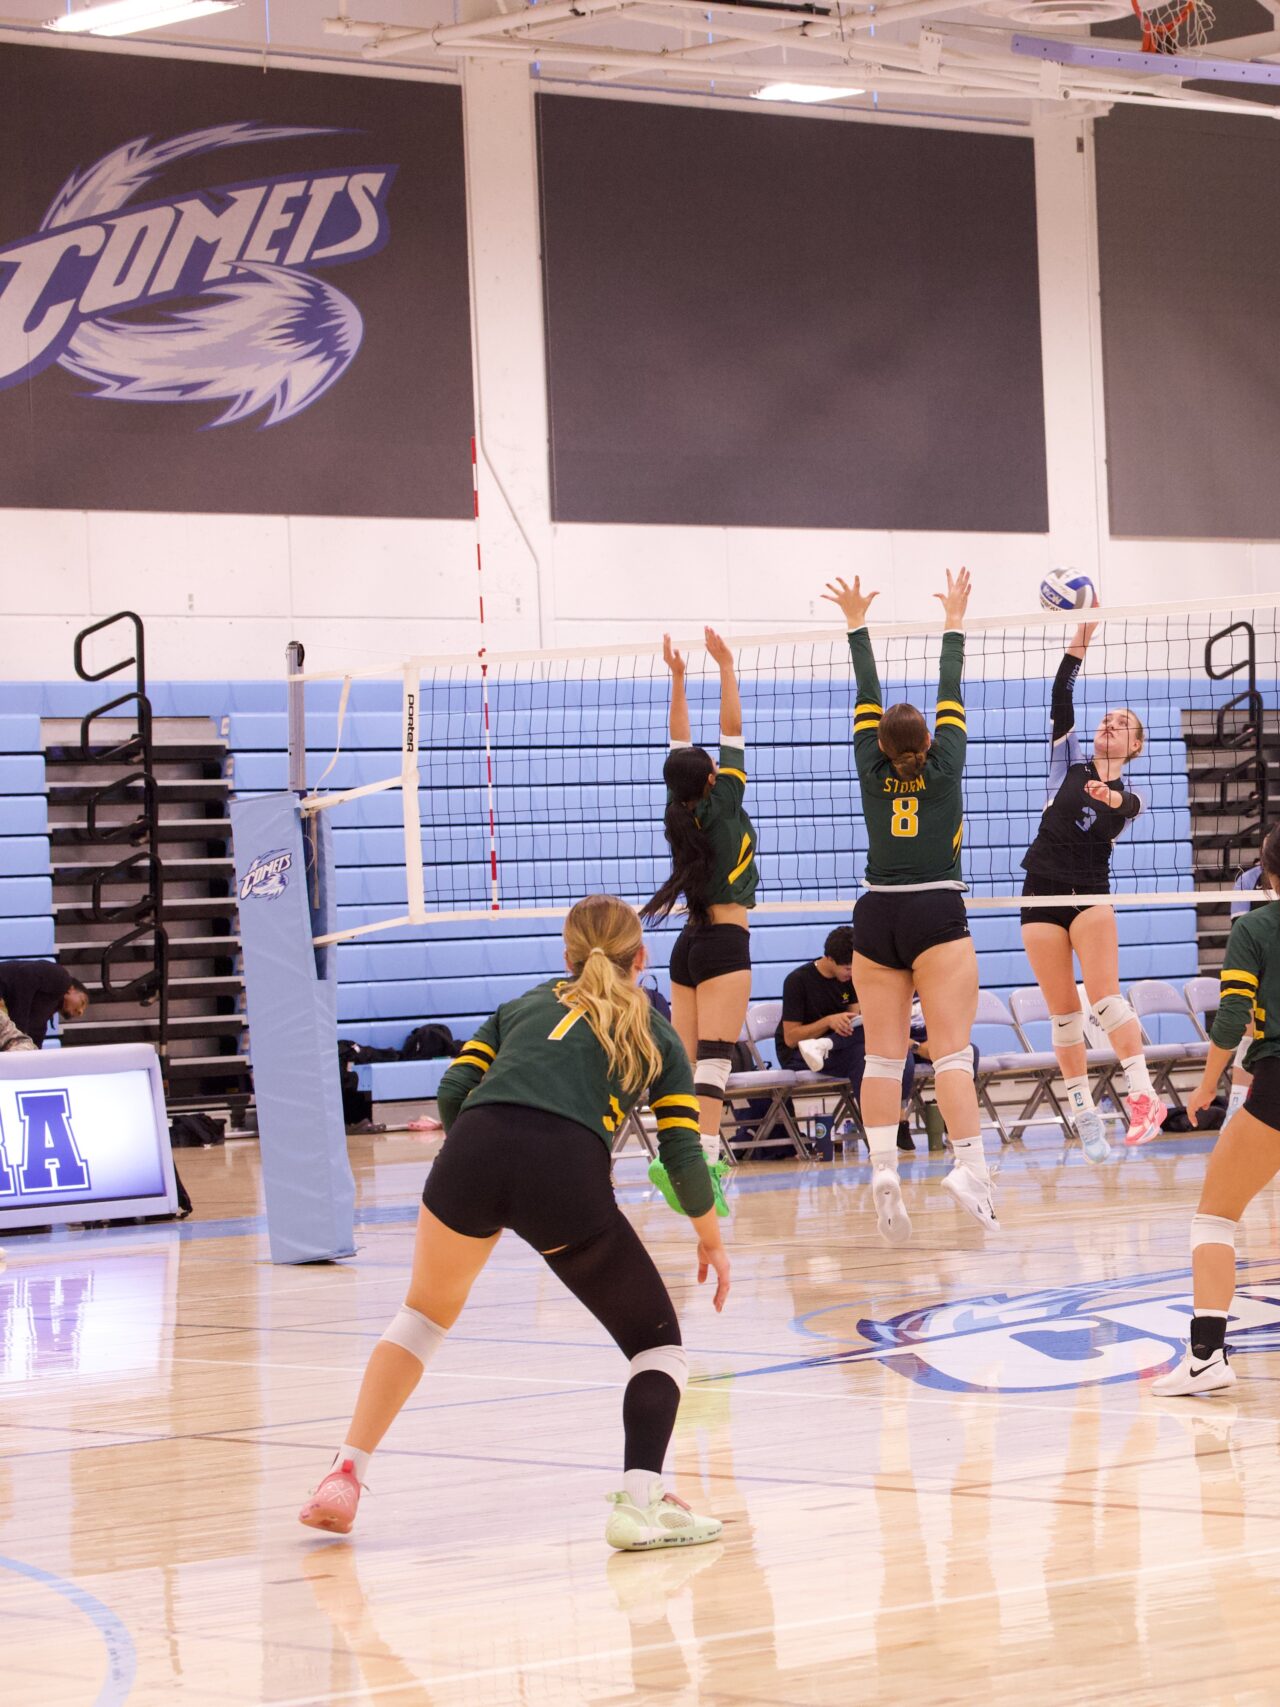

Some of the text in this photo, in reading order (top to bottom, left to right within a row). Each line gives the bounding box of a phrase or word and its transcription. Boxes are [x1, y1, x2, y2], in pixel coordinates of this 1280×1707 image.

[883, 774, 926, 793] STORM
[891, 796, 919, 838] 8
[1075, 806, 1097, 832] 3
